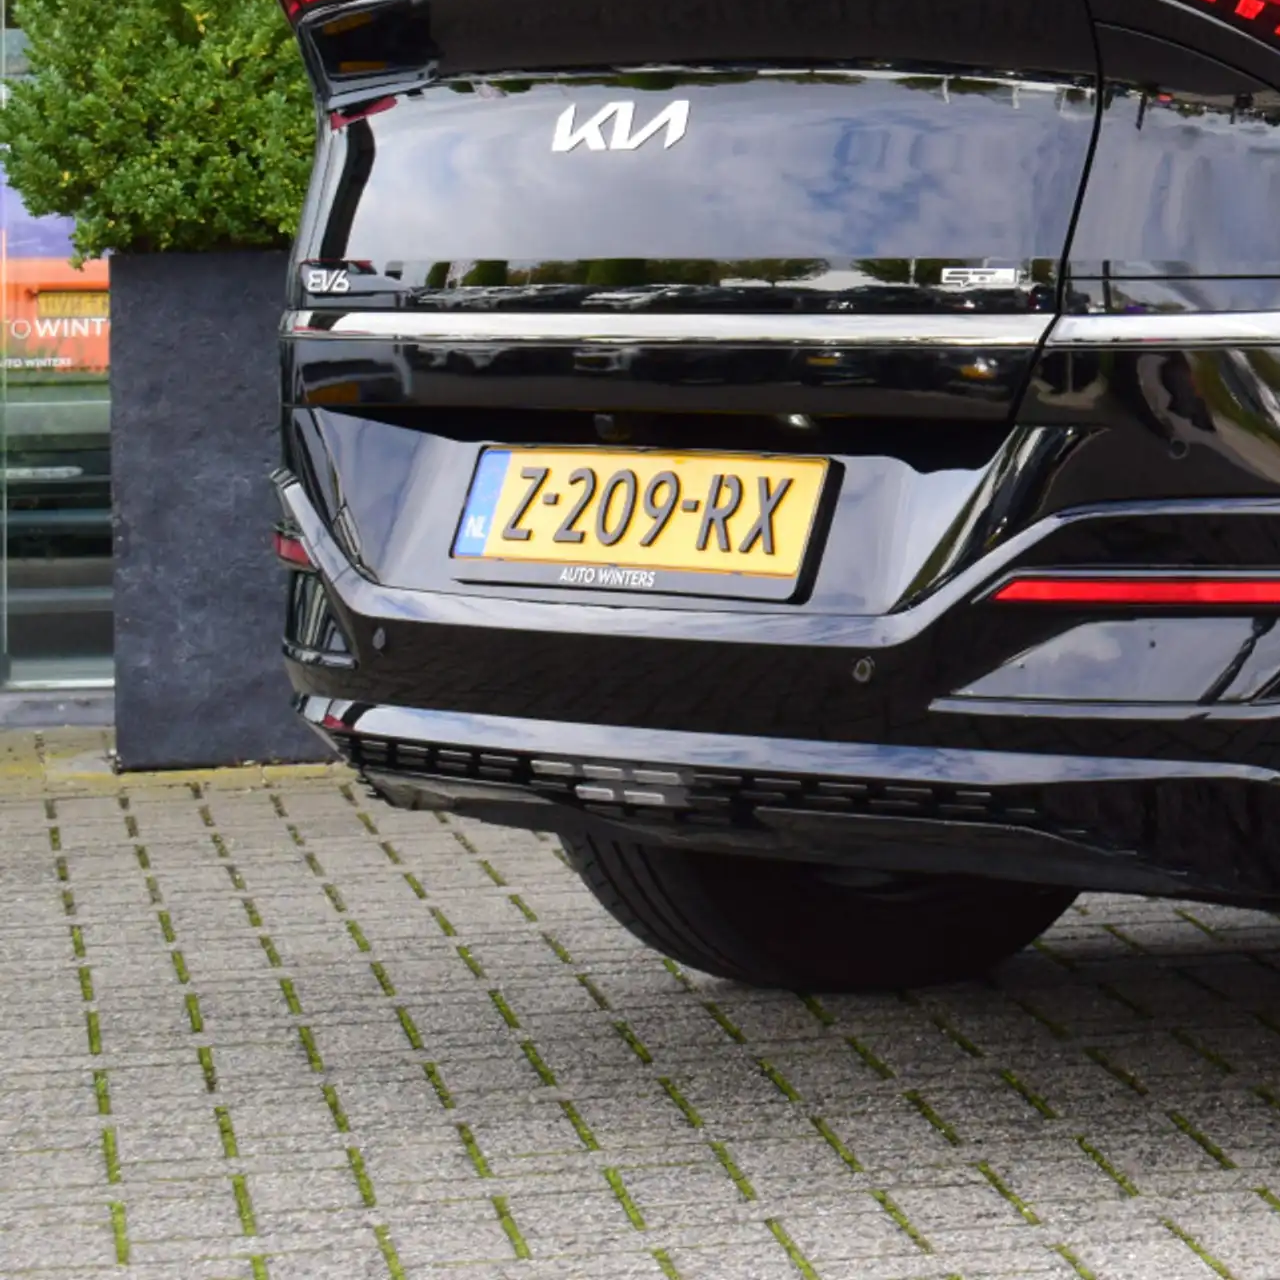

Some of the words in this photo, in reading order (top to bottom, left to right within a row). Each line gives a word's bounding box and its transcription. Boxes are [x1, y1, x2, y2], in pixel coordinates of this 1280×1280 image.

[551, 99, 691, 152] KIA
[307, 269, 350, 293] EV6
[464, 514, 486, 539] NL
[501, 466, 794, 556] Z-209-RX
[559, 566, 596, 584] AUTO
[598, 568, 656, 588] WINTERS
